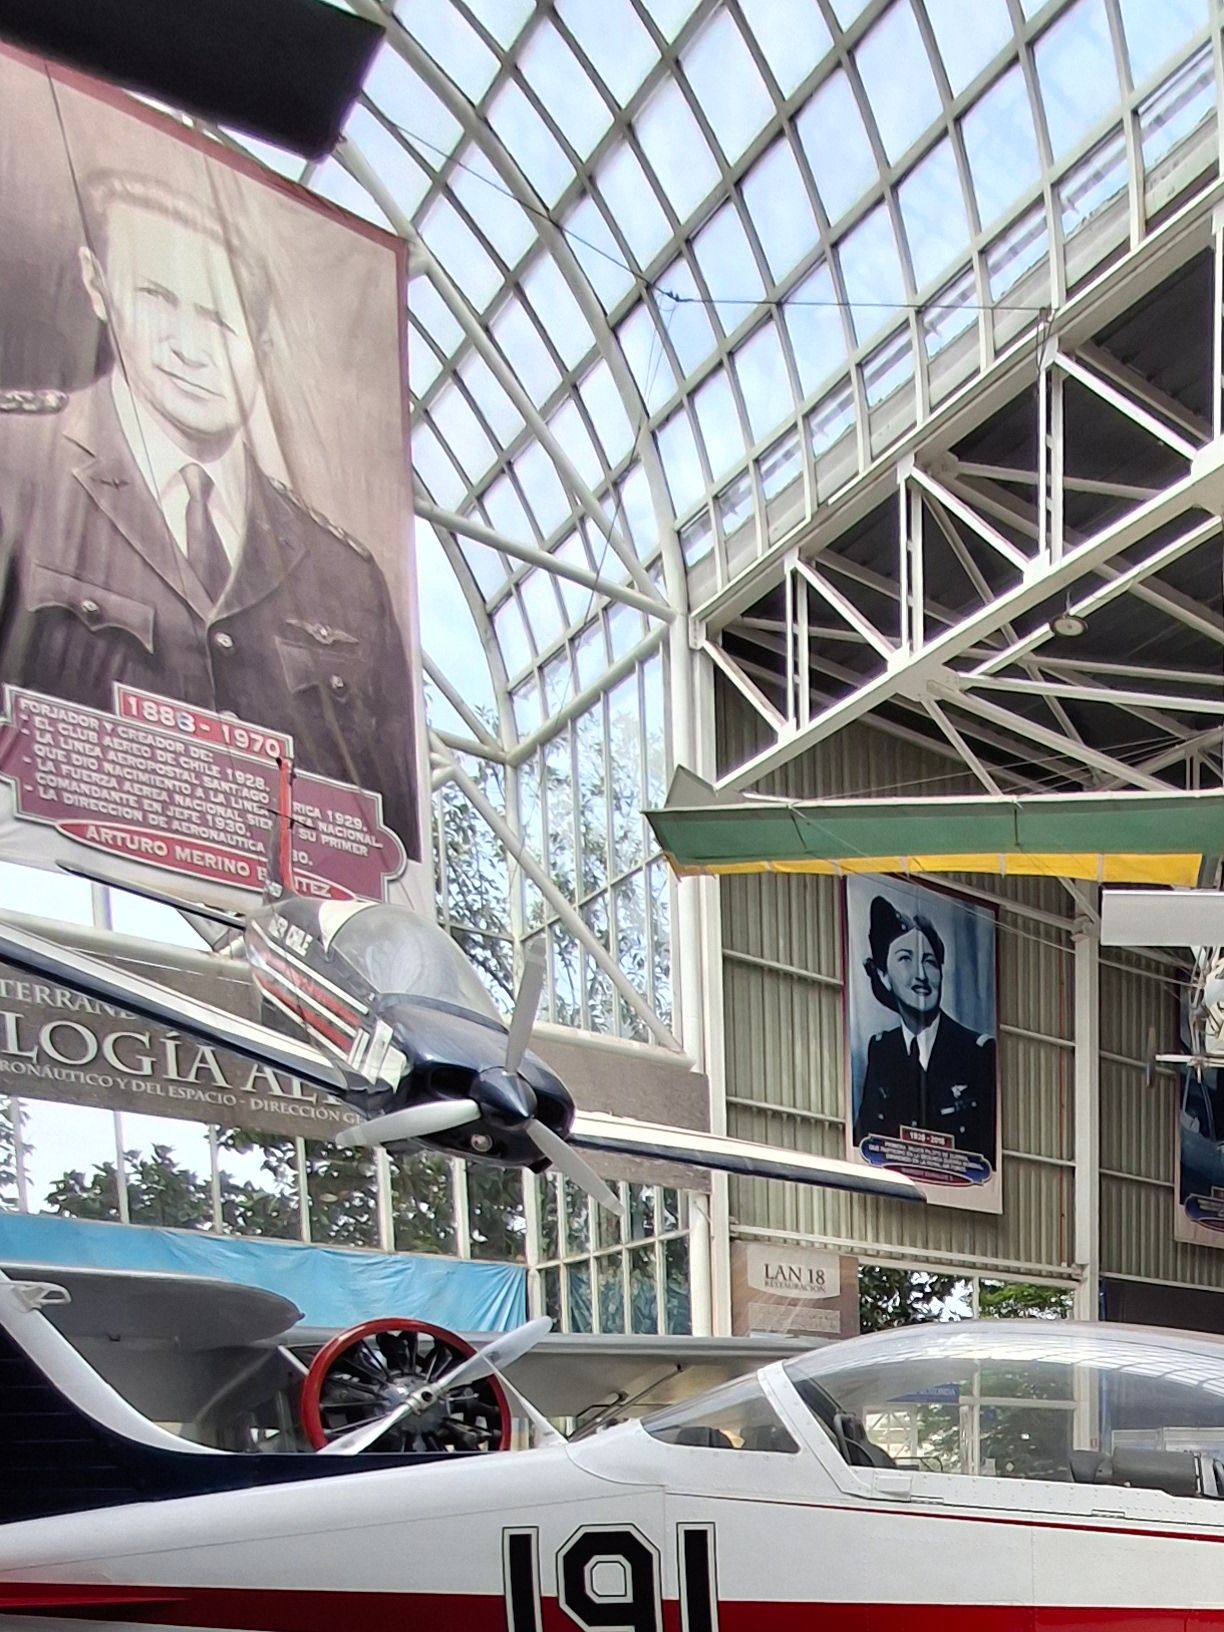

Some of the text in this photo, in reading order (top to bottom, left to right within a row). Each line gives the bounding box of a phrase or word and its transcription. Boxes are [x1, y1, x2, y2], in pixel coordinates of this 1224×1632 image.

[20, 698, 214, 762] FORJADOR Y CREADOR DE:
[34, 715, 54, 732] EL
[58, 722, 98, 743] CLUB
[103, 735, 151, 757] AEREO
[156, 750, 177, 766] DE
[179, 756, 221, 778] CHILE
[226, 768, 270, 792] 1928.
[221, 723, 280, 758] 1970
[33, 743, 68, 763] QUE
[71, 752, 99, 770] DIO
[102, 761, 191, 794] NACIMIENTO
[195, 787, 205, 799] A
[208, 790, 227, 805] LA
[35, 730, 55, 746] LA
[59, 736, 103, 759] LINEA
[107, 751, 200, 785] AEROPOSTAL
[203, 776, 270, 804] SANTIAGO
[326, 810, 368, 832] 1929.
[35, 772, 251, 837] COMANDANTE EN JEFE 1930.
[37, 759, 56, 774] LA
[60, 764, 120, 790] FUERZA
[123, 781, 170, 803] AEREA
[173, 793, 243, 822] NACIONAL
[298, 828, 317, 842] SU
[320, 835, 368, 857] PRIMER
[39, 785, 58, 801] LA
[62, 791, 143, 822] DIRECCION
[147, 812, 169, 829] DE
[171, 820, 266, 854] AERONAUTICA
[85, 824, 168, 857] ARTURO
[174, 845, 251, 877] MERINO
[0, 1010, 233, 1089] LOGÍA
[114, 1077, 131, 1091] Y
[132, 1080, 166, 1097] DEL
[169, 1085, 237, 1107] ESPACIO
[250, 1098, 342, 1122] DIRECCIÓN
[764, 1262, 826, 1286] LAN 18
